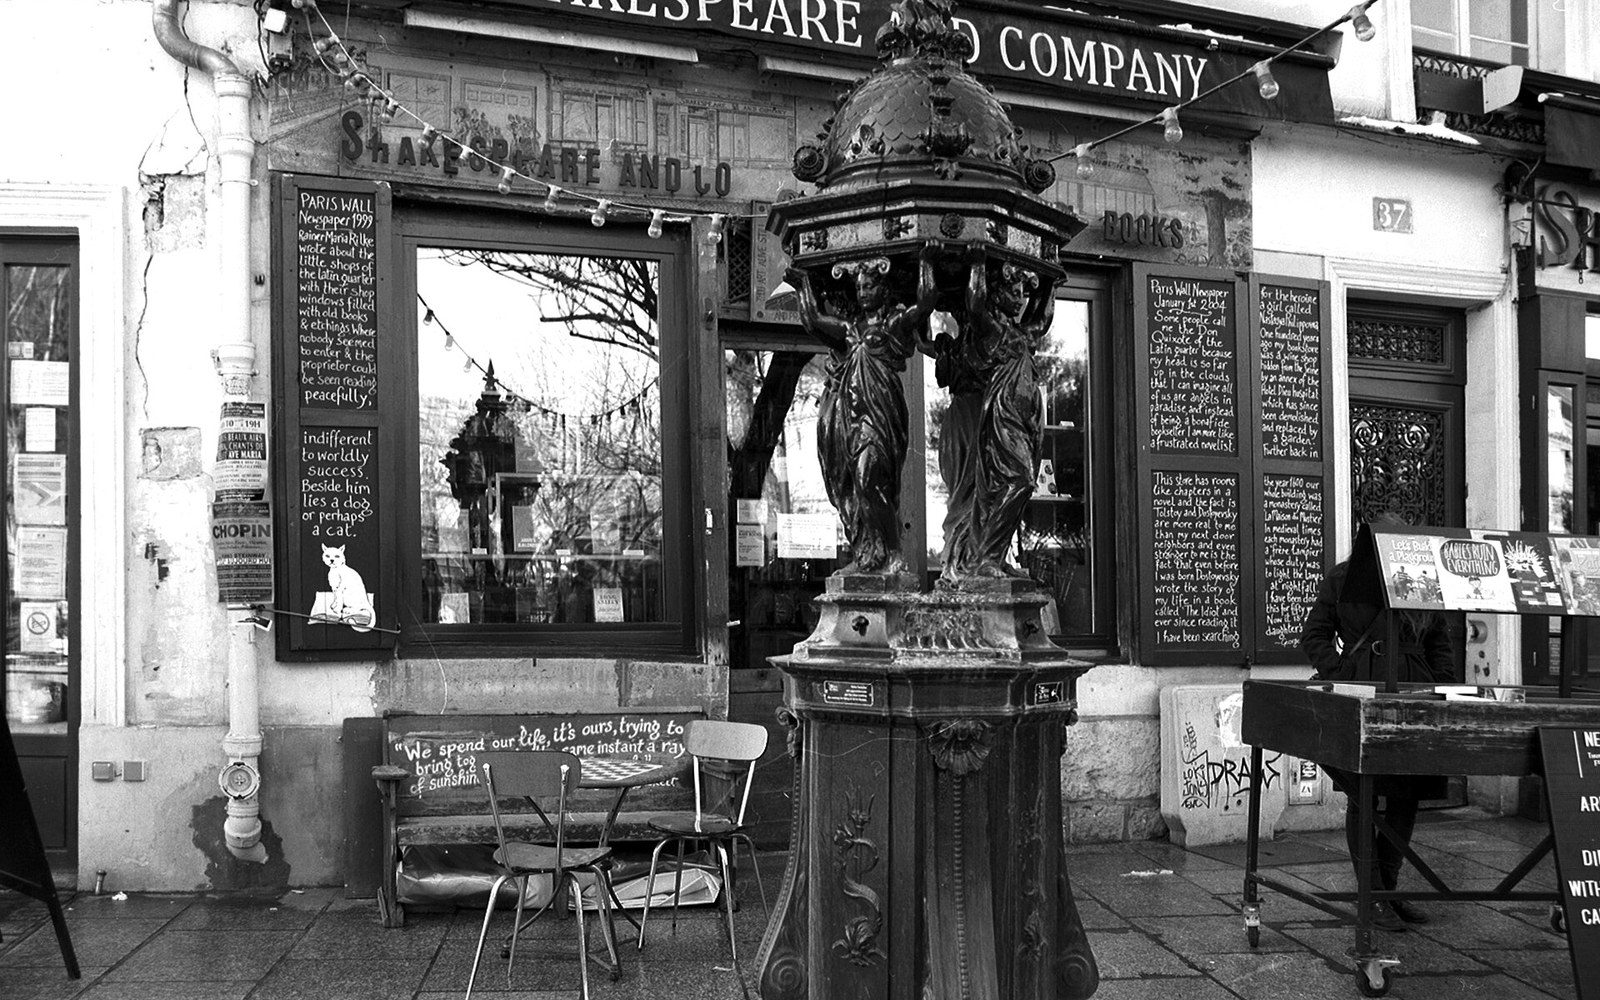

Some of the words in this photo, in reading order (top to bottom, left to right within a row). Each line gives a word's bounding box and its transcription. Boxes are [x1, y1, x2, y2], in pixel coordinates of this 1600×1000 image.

[1000, 26, 1208, 100] COMPANY
[619, 153, 681, 194] AND
[301, 192, 338, 211] PARIS
[341, 198, 373, 213] WALL
[299, 210, 350, 231] Newspaper
[352, 213, 373, 229] 1999
[1378, 202, 1407, 228] 37
[1104, 210, 1184, 249] BOOKS
[325, 231, 348, 245] Maria
[349, 231, 374, 248] Rilke
[299, 242, 327, 255] wrote
[330, 245, 355, 259] about
[359, 247, 374, 261] the
[299, 254, 327, 268] little
[330, 258, 360, 274] shops
[362, 261, 374, 277] of
[299, 267, 316, 280] the
[340, 272, 375, 288] quarter
[300, 280, 320, 293] with
[323, 281, 348, 296] their
[350, 285, 375, 302] shop
[1151, 279, 1173, 295] Paris
[1173, 281, 1191, 296] Wall
[299, 293, 344, 307] windows
[347, 296, 375, 312] filled
[1154, 294, 1185, 315] January
[1200, 299, 1227, 314] 2004
[1260, 301, 1265, 310] a
[1266, 301, 1283, 315] girl
[1285, 303, 1312, 315] called
[299, 305, 320, 318] with
[322, 307, 338, 319] old
[341, 307, 368, 323] books
[1154, 309, 1179, 323] Some
[1182, 314, 1210, 329] people
[1212, 315, 1226, 328] call
[300, 318, 308, 330] &
[310, 319, 350, 337] etchings
[299, 331, 334, 347] nobody
[335, 337, 375, 350] seemed
[1151, 330, 1192, 346] Quixote
[1194, 335, 1203, 348] of
[1206, 336, 1224, 348] the
[301, 345, 311, 356] to
[313, 345, 342, 358] enter
[344, 346, 352, 360] &
[355, 349, 374, 362] the
[301, 359, 351, 375] proprietor
[352, 362, 377, 375] could
[1153, 369, 1165, 380] up
[1168, 368, 1177, 378] in
[1180, 367, 1195, 379] the
[1199, 369, 1230, 382] clouds
[302, 372, 315, 385] be
[317, 376, 341, 386] seen
[343, 375, 377, 395] reading
[303, 429, 373, 447] indifferent
[1150, 439, 1156, 448] a
[1156, 434, 1199, 451] frustrated
[301, 448, 315, 462] to
[317, 447, 370, 466] worldly
[1263, 443, 1288, 456] Further
[1289, 444, 1307, 457] back
[1310, 447, 1318, 458] in
[302, 479, 343, 494] Beside
[346, 480, 371, 494] him
[1153, 472, 1173, 486] This
[1175, 473, 1193, 486] store
[1195, 474, 1209, 486] has
[1212, 477, 1236, 487] rooms
[303, 494, 327, 508] lies
[331, 497, 339, 508] a
[343, 495, 373, 517] dog
[1153, 496, 1176, 507] novel
[1177, 497, 1192, 507] and
[1195, 496, 1208, 507] the
[1209, 496, 1225, 512] fact
[1228, 498, 1236, 508] is
[302, 511, 315, 521] or
[319, 510, 366, 525] perhaps
[212, 524, 271, 539] CHOPIN
[312, 525, 320, 536] a
[326, 524, 357, 537] cat.
[1155, 529, 1174, 539] than
[1177, 532, 1189, 542] my
[1191, 529, 1209, 540] next
[1212, 531, 1235, 540] door
[1444, 542, 1471, 559] BABIES
[1472, 543, 1494, 561] RUIN
[1286, 555, 1304, 571] duty
[1306, 561, 1320, 569] was
[1447, 558, 1498, 575] EVERYTHING
[1265, 567, 1272, 578] to
[1274, 567, 1290, 583] light
[1293, 568, 1303, 579] the
[1155, 582, 1180, 593] wrote
[1184, 582, 1198, 593] the
[1201, 582, 1223, 596] story
[1226, 581, 1235, 597] of
[1154, 619, 1172, 628] ever
[1174, 617, 1197, 627] since
[1198, 617, 1229, 633] reading
[1230, 617, 1237, 628] it
[439, 738, 485, 758] spend
[492, 737, 515, 748] our
[518, 725, 551, 749] life,
[553, 722, 576, 742] it's
[582, 721, 617, 736] ours,
[620, 717, 660, 740] trying
[667, 720, 684, 735] to
[597, 739, 644, 755] instant
[646, 742, 655, 753] a
[662, 741, 686, 759] ray
[416, 759, 454, 777] bring
[410, 777, 425, 799] of
[429, 770, 480, 790] sunshin
